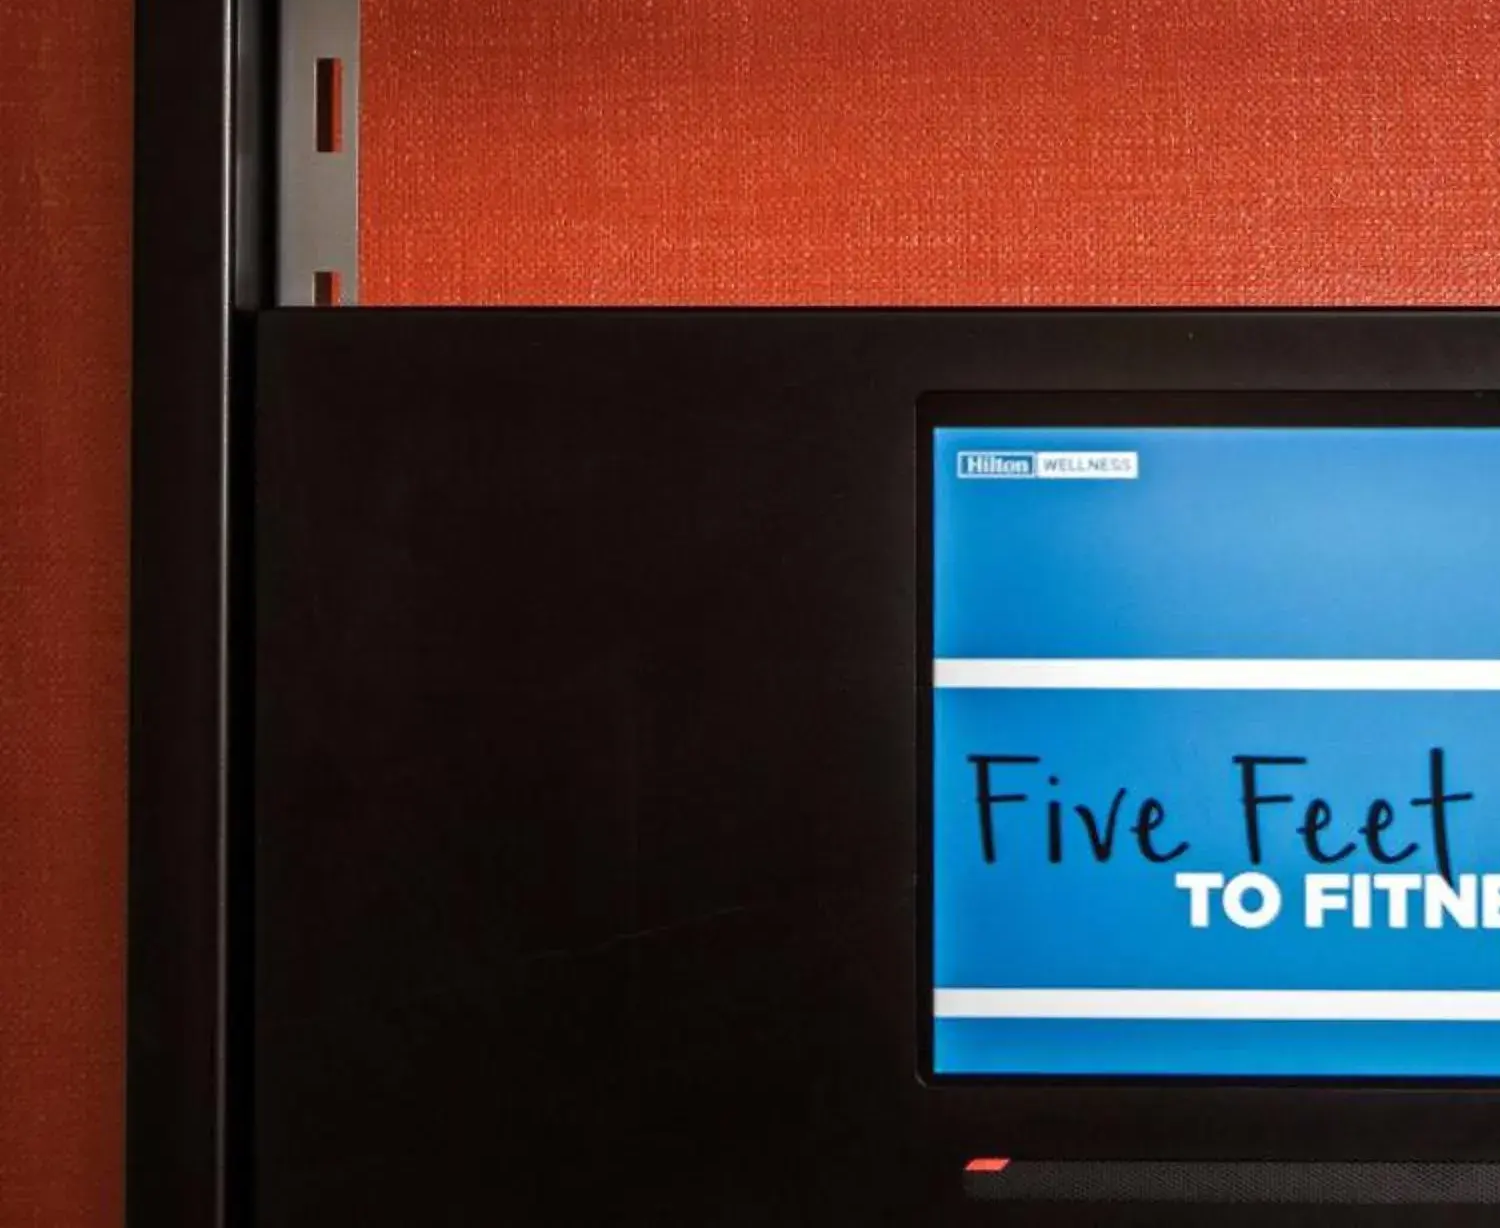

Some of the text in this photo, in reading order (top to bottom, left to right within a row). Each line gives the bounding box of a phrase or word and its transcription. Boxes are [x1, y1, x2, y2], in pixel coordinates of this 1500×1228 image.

[965, 455, 1133, 474] Hilton WELLNESS
[966, 747, 1474, 889] Five Feet
[1175, 872, 1282, 929] TO
